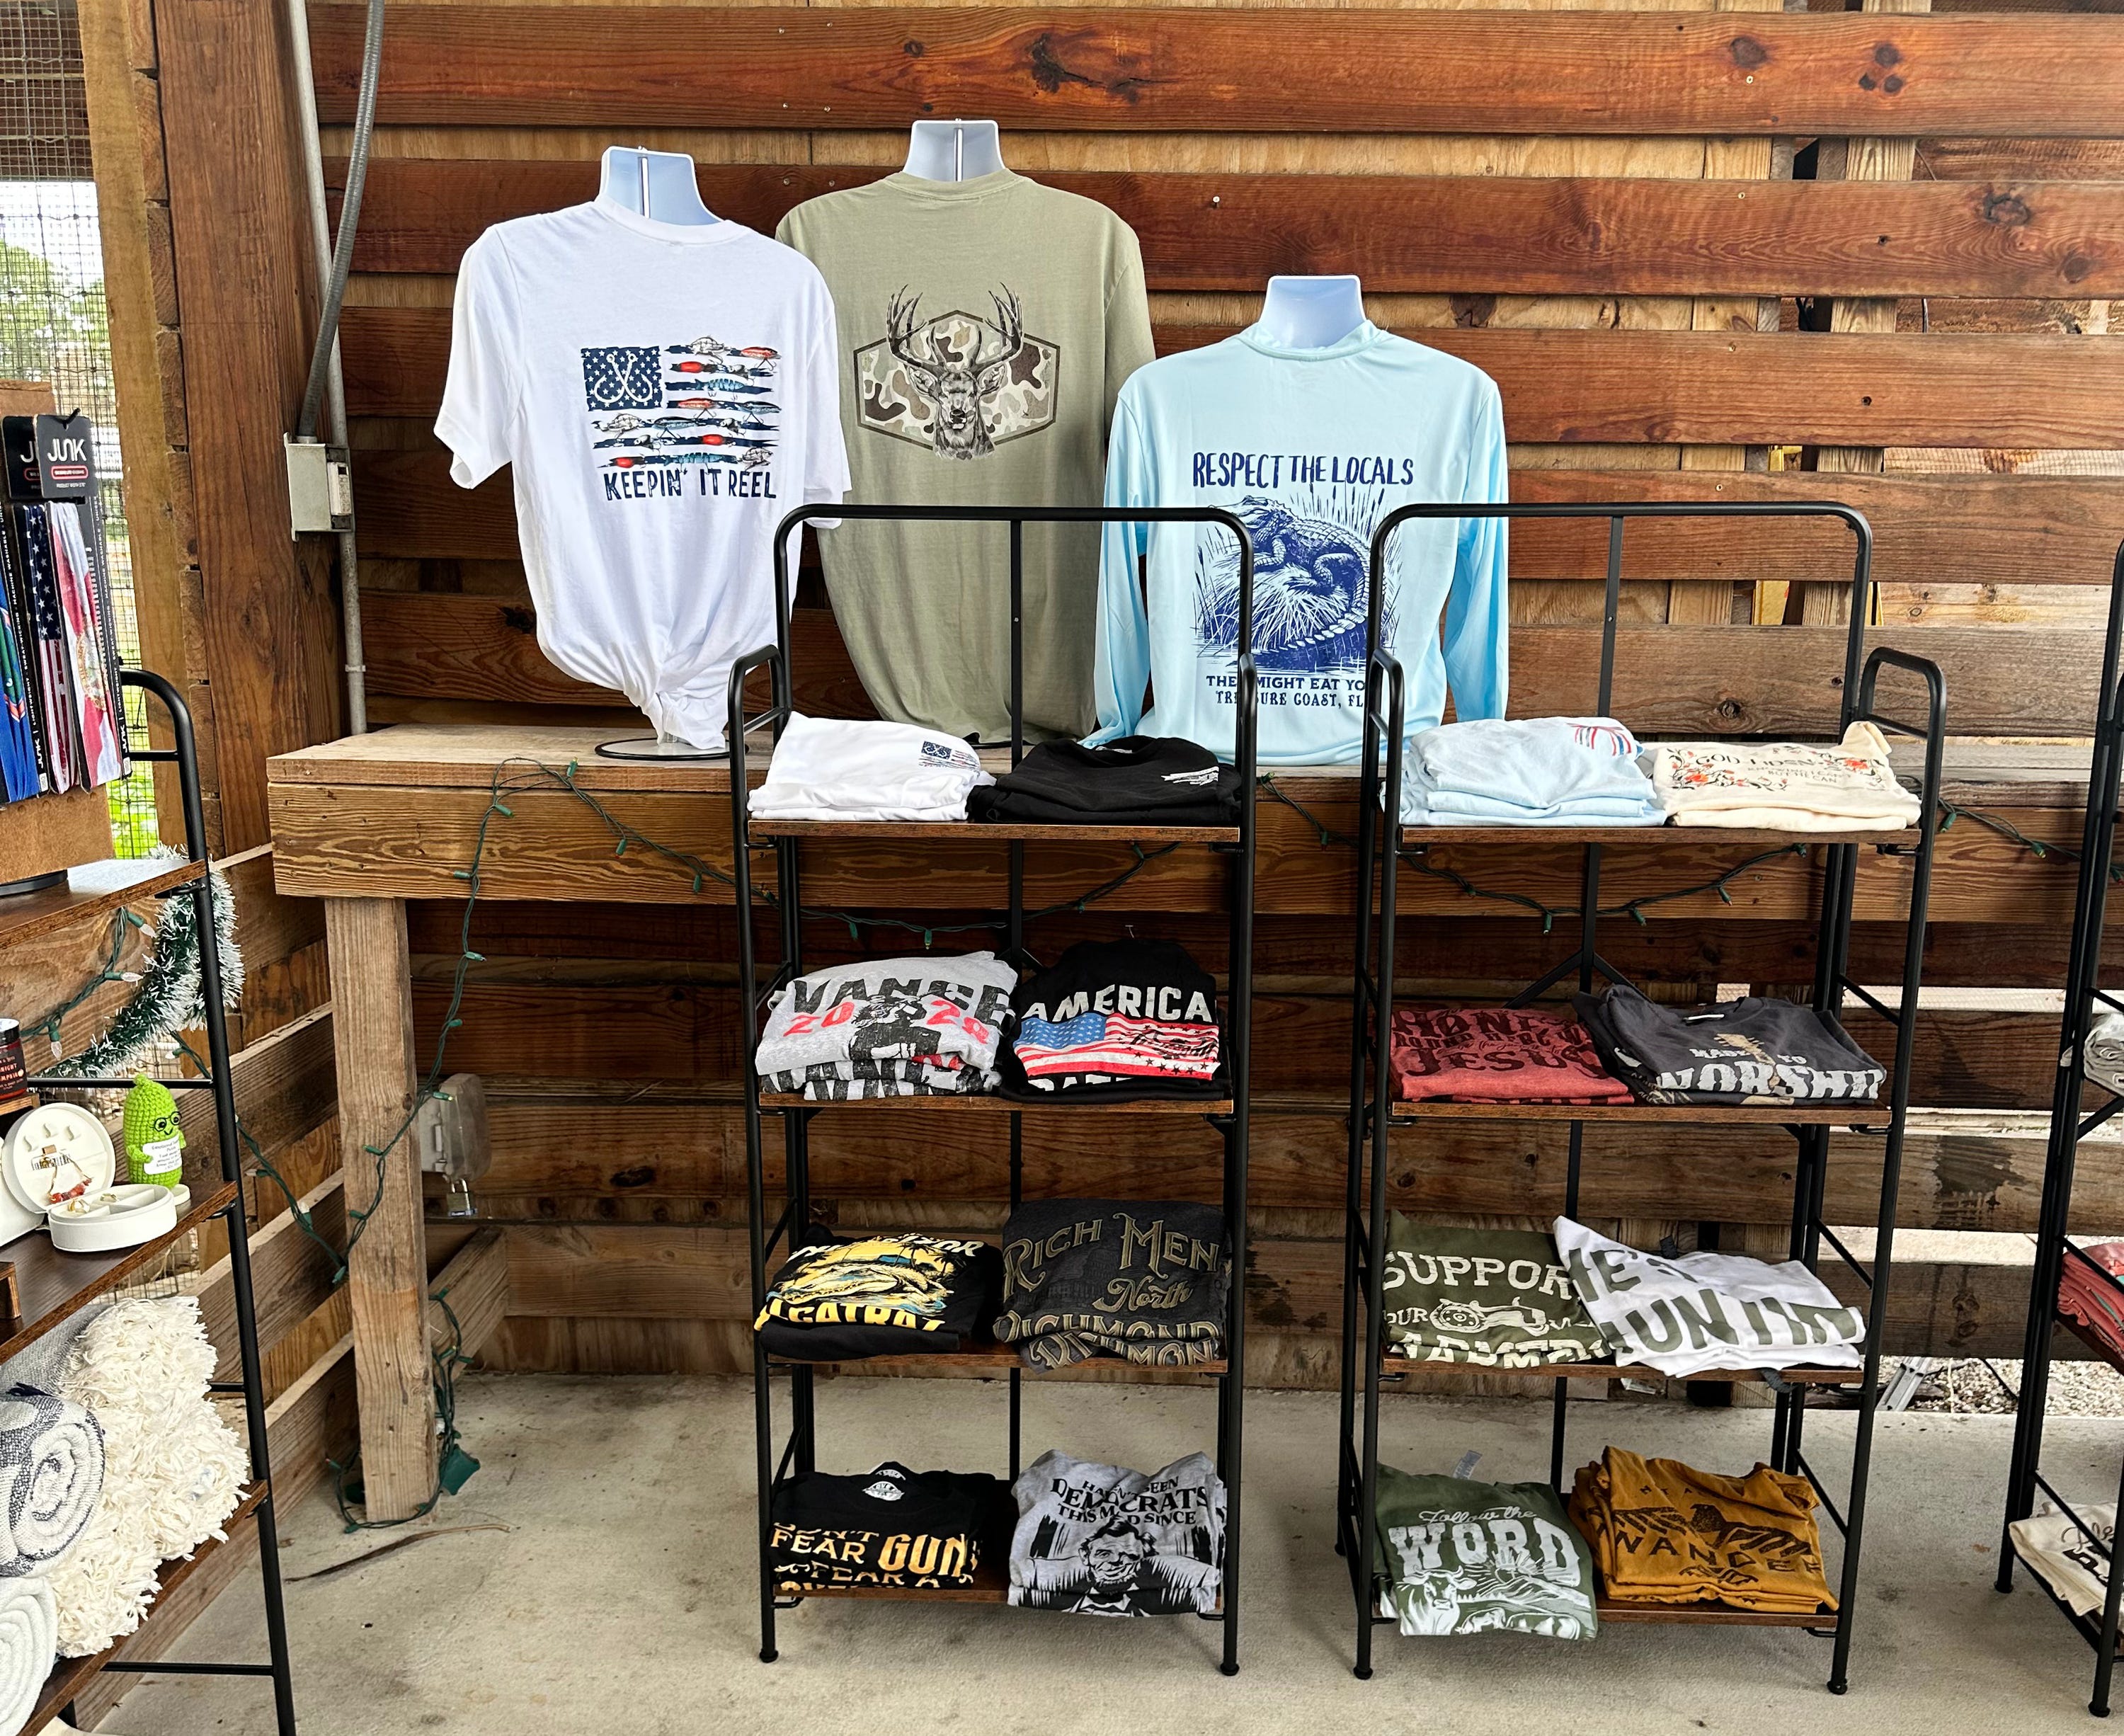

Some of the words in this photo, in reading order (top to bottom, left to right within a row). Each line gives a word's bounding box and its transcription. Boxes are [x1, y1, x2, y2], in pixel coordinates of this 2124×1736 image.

[47, 438, 86, 462] JUNK
[603, 467, 687, 501] KEEPIN'
[700, 469, 722, 496] IT
[729, 469, 777, 498] REEL
[1193, 452, 1284, 489] RESPECT
[1288, 455, 1327, 483] THE
[1332, 456, 1414, 486] LOCALS
[2, 530, 12, 570] WASHABLE
[1206, 675, 1237, 687] THE
[1257, 677, 1305, 689] MIGHT
[1310, 678, 1340, 690] EAT
[1347, 680, 1365, 691] YO
[1216, 690, 1286, 705] TRURE
[1294, 693, 1342, 709] COAST,
[34, 738, 44, 769] JUNK
[120, 724, 129, 753] JUNK
[783, 1001, 855, 1037] 20
[1021, 984, 1213, 1023] AMERICA
[1405, 1046, 1609, 1079] JESUS
[1777, 1054, 1807, 1064] TO
[1003, 1218, 1103, 1303] RICH
[1112, 1212, 1219, 1280] MEN
[1383, 1250, 1572, 1301] SUPPOR
[1092, 1275, 1194, 1313] North
[1383, 1307, 1429, 1325] OUR
[1051, 1478, 1208, 1514] DEMOCRATS
[1058, 1503, 1097, 1524] THIS
[1143, 1511, 1196, 1526] SINCE
[1418, 1509, 1500, 1524] Follow
[770, 1527, 866, 1565] FEAR
[877, 1534, 969, 1577] GUN
[1388, 1517, 1581, 1587] WORD
